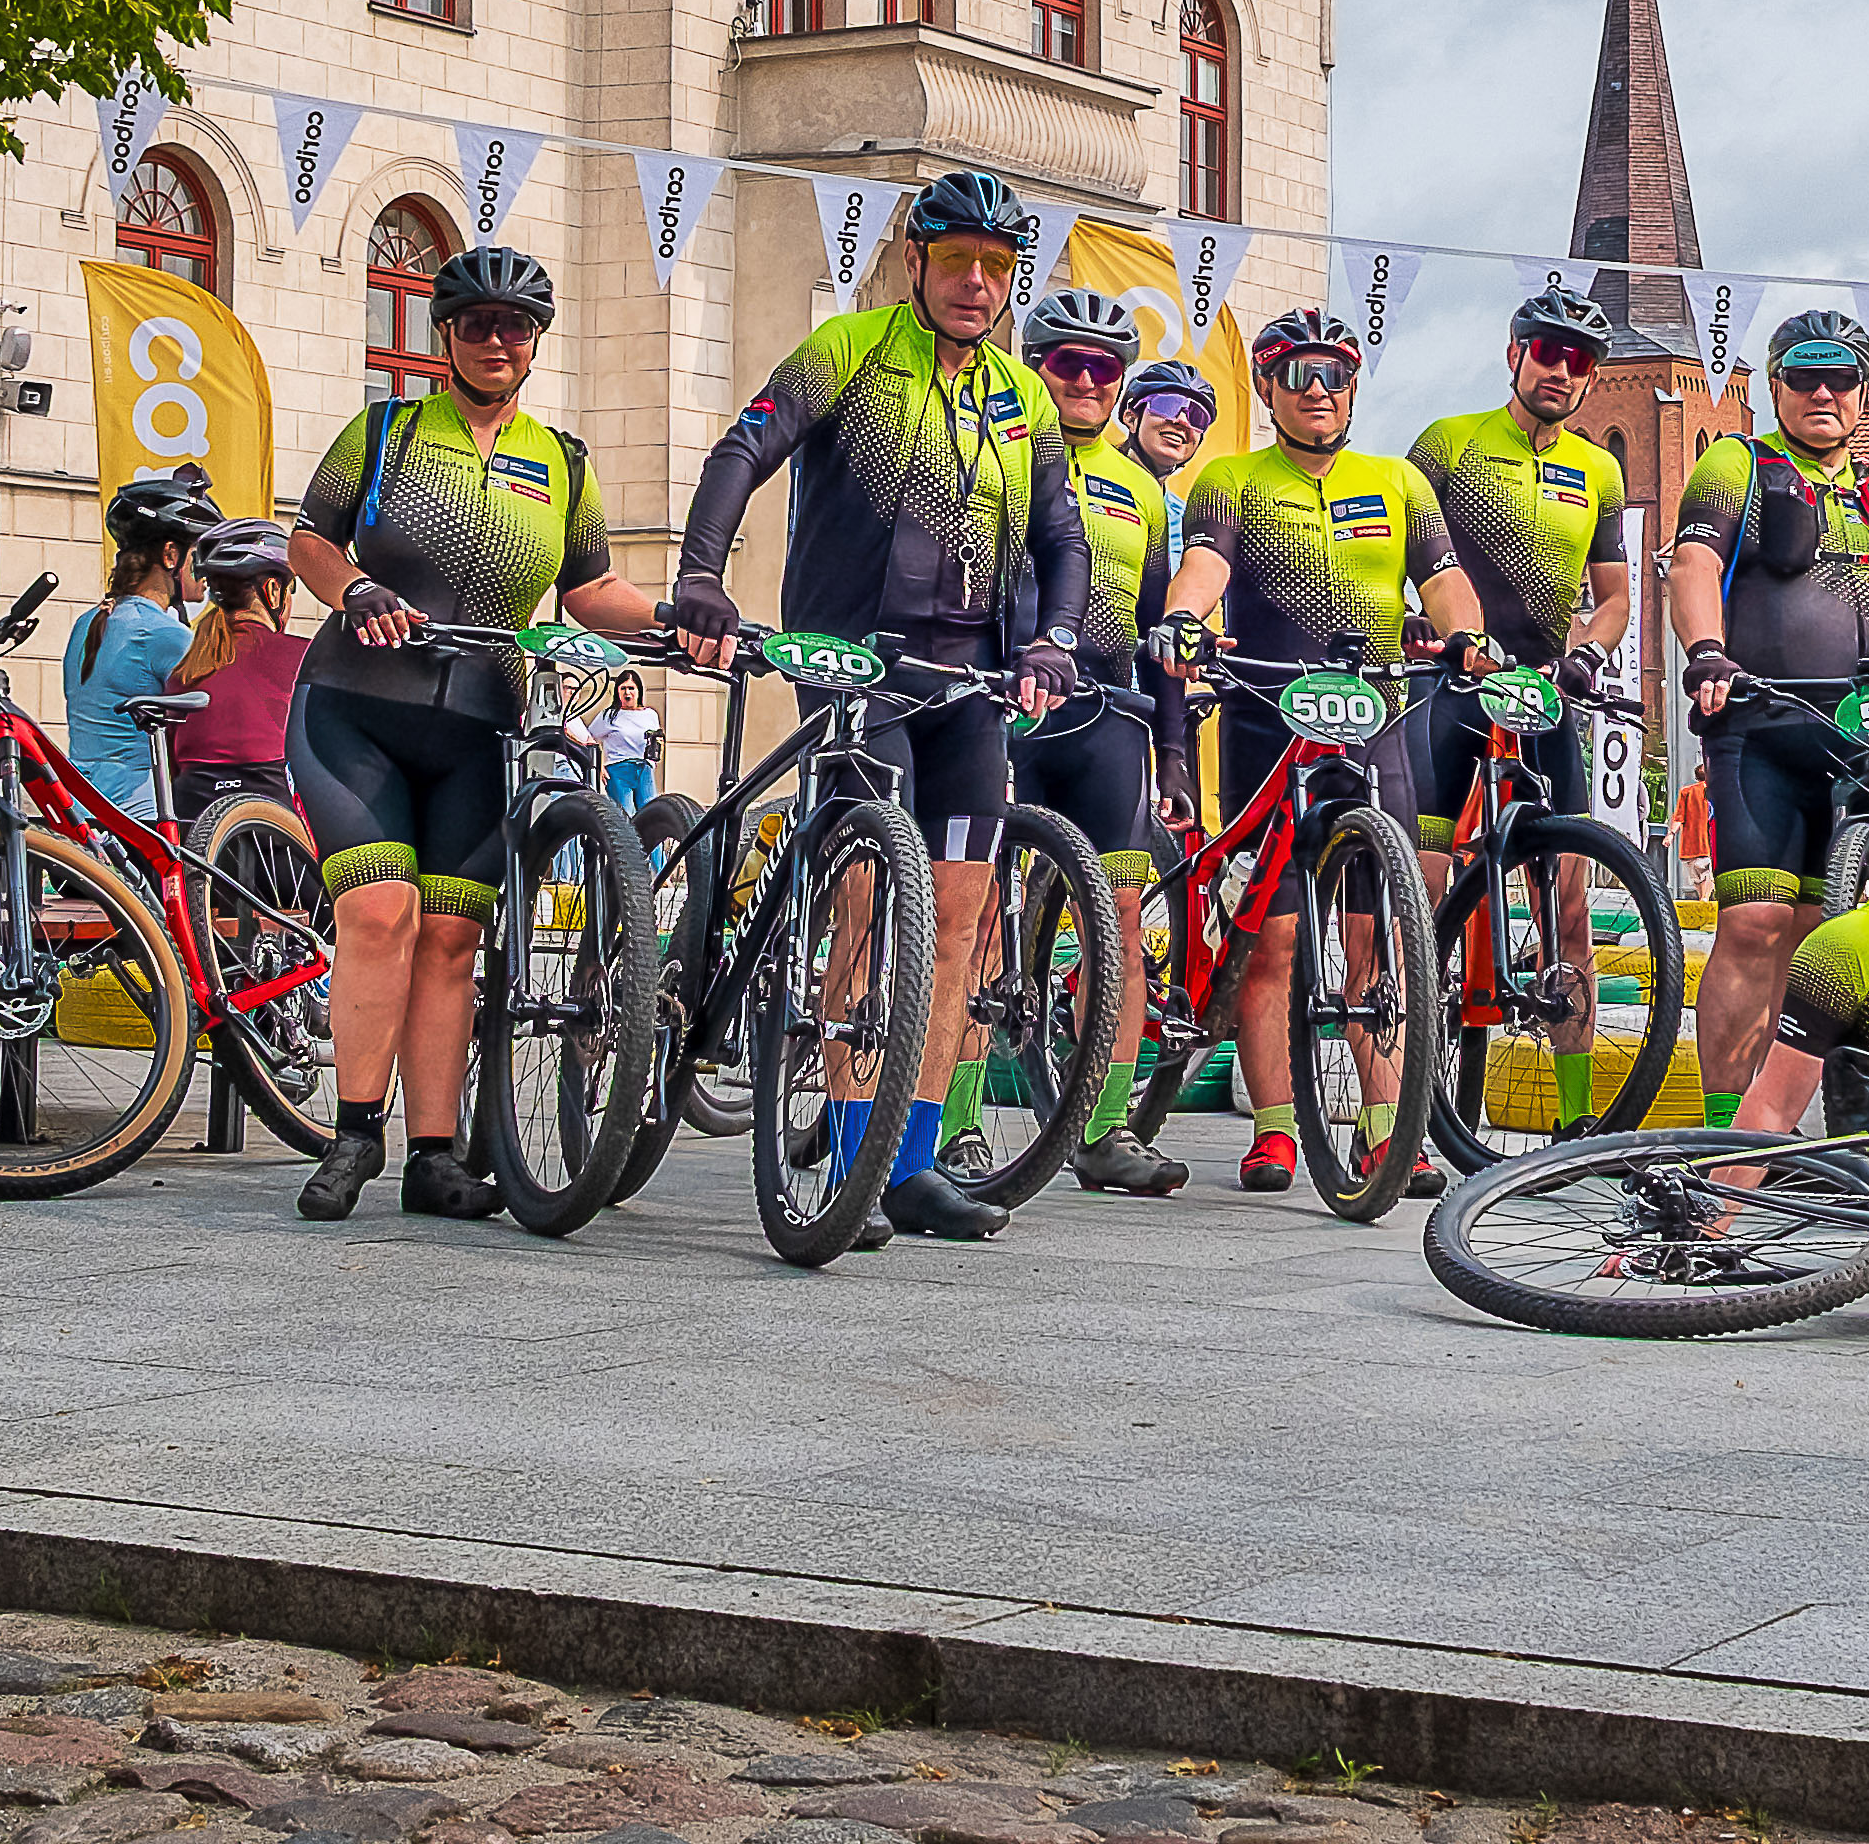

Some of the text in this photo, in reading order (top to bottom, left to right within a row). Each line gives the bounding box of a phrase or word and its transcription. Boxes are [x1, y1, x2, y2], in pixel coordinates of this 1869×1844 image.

[1794, 350, 1842, 360] GARMIN
[780, 643, 874, 676] 140
[1291, 693, 1375, 725] 500
[1505, 683, 1545, 716] 79
